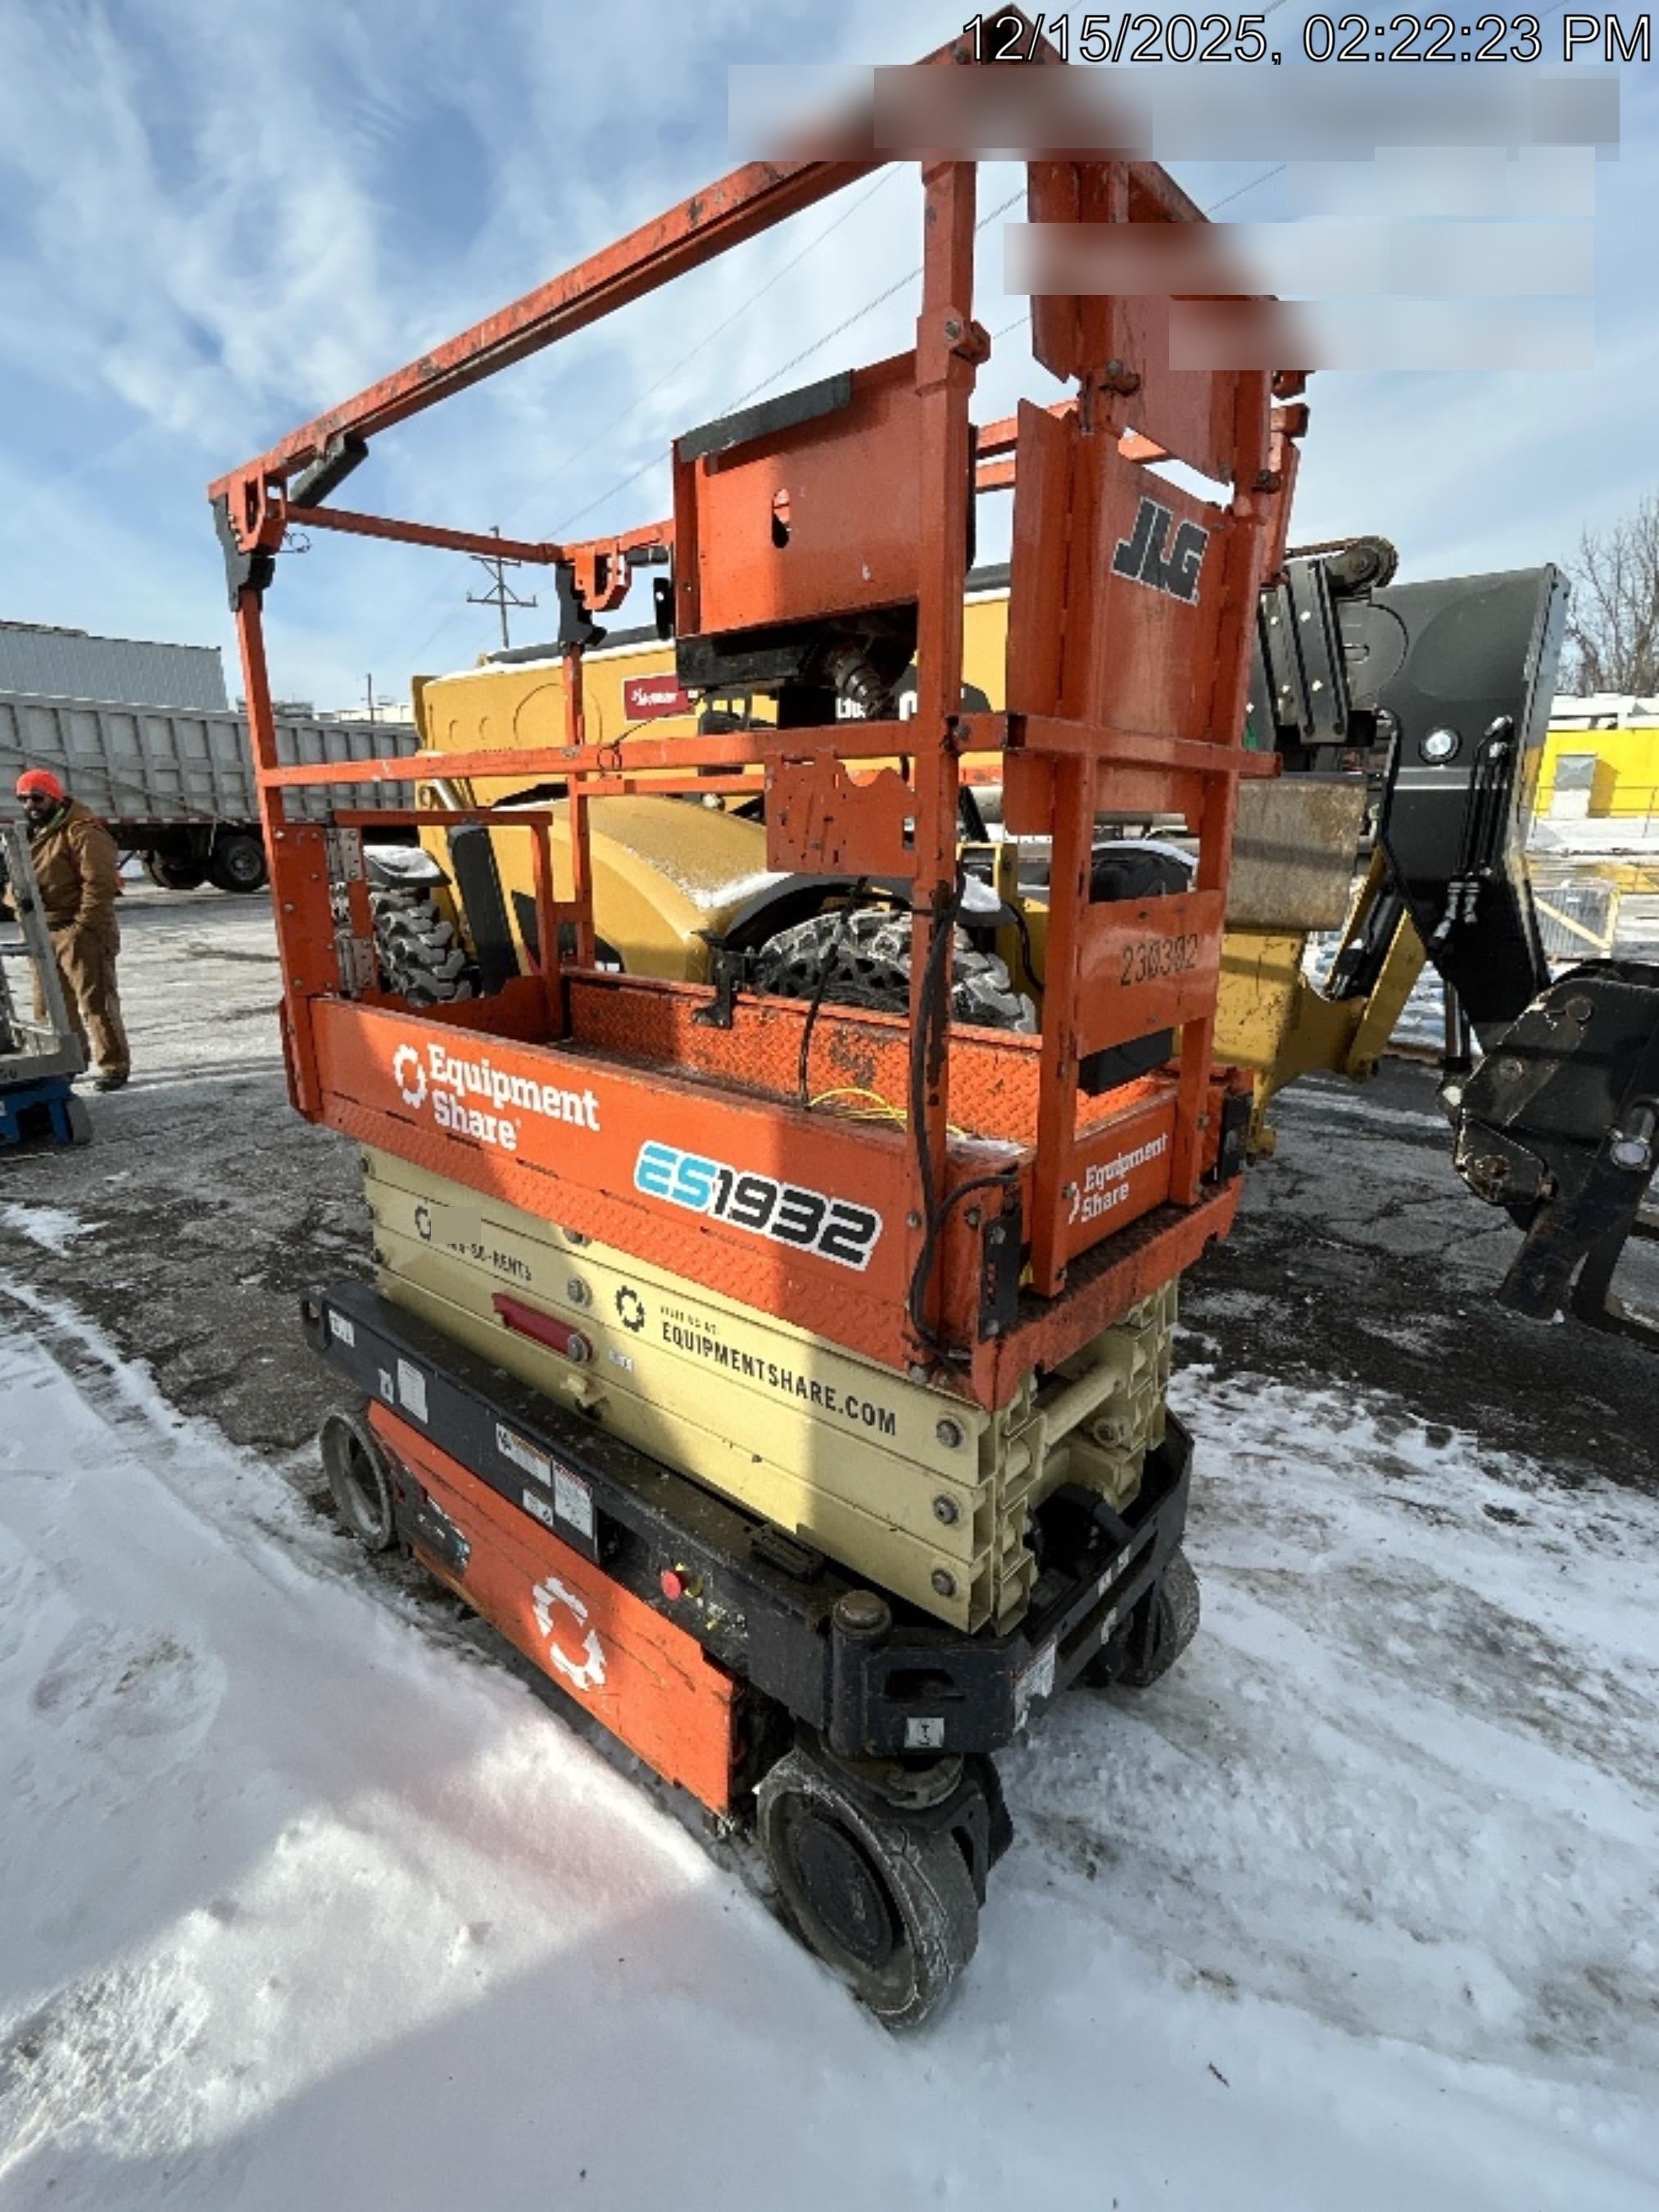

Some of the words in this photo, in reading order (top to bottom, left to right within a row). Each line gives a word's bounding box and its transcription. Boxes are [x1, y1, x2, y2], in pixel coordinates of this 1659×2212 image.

[1111, 496, 1211, 608] JLG
[427, 1042, 601, 1132] Equipment
[432, 1088, 518, 1152] Share
[635, 1140, 882, 1271] ES1932
[1081, 1182, 1130, 1223] Share
[1083, 1131, 1168, 1193] Equipment
[662, 1321, 896, 1436] EQUIPMENTSHARE.COM
